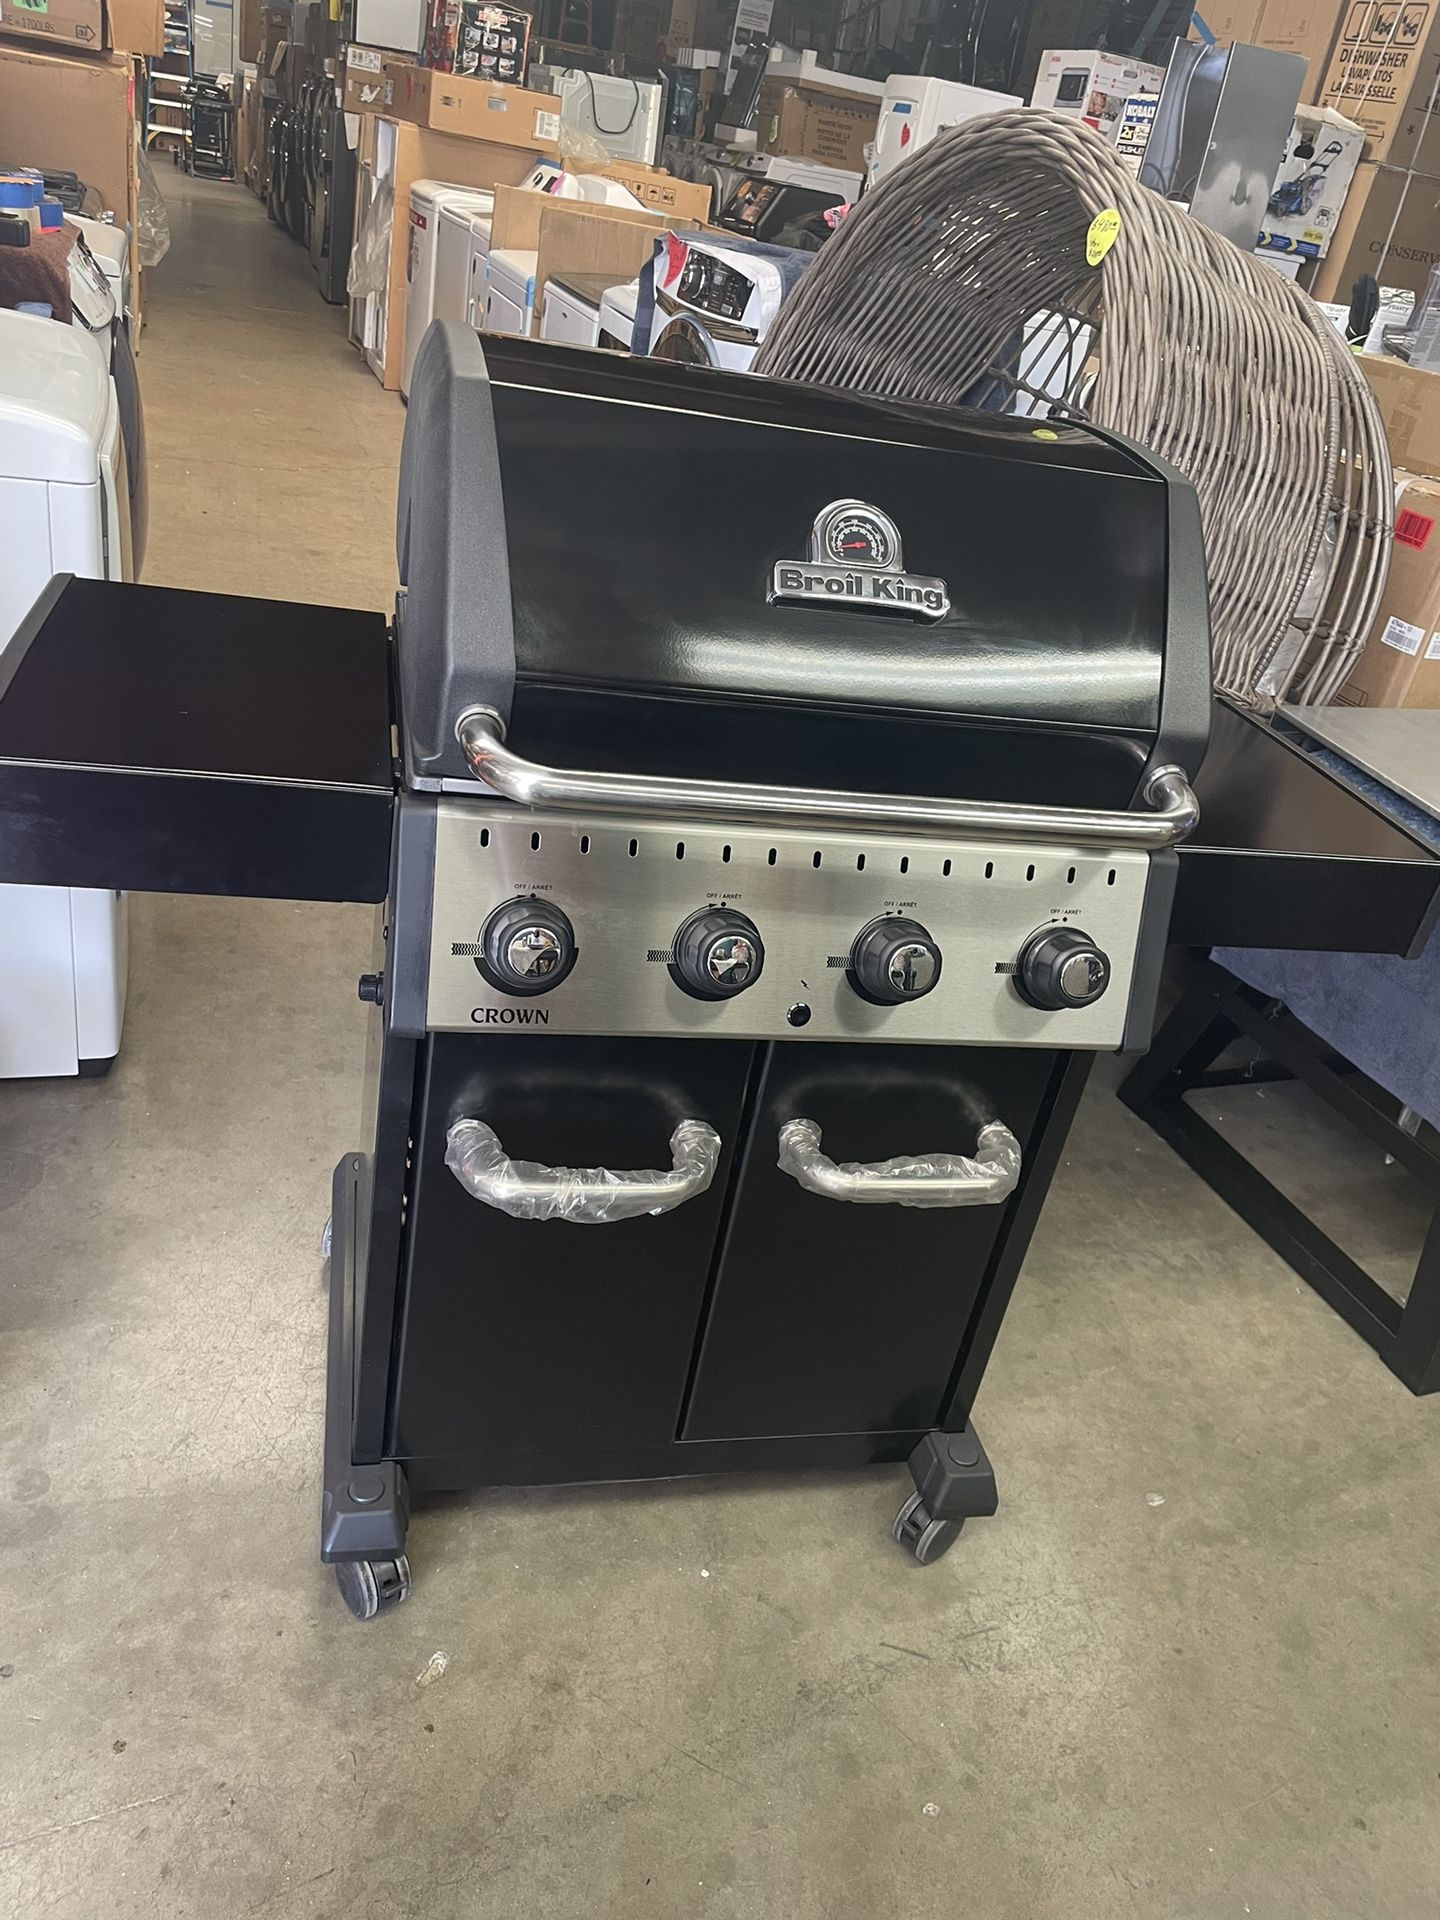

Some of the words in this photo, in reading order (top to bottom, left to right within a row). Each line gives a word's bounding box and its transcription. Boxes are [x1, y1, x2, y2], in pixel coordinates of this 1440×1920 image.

[1339, 48, 1409, 68] DISHWASHER
[1330, 80, 1397, 99] LAVE-VASSELLE
[470, 1007, 549, 1025] CROWN
